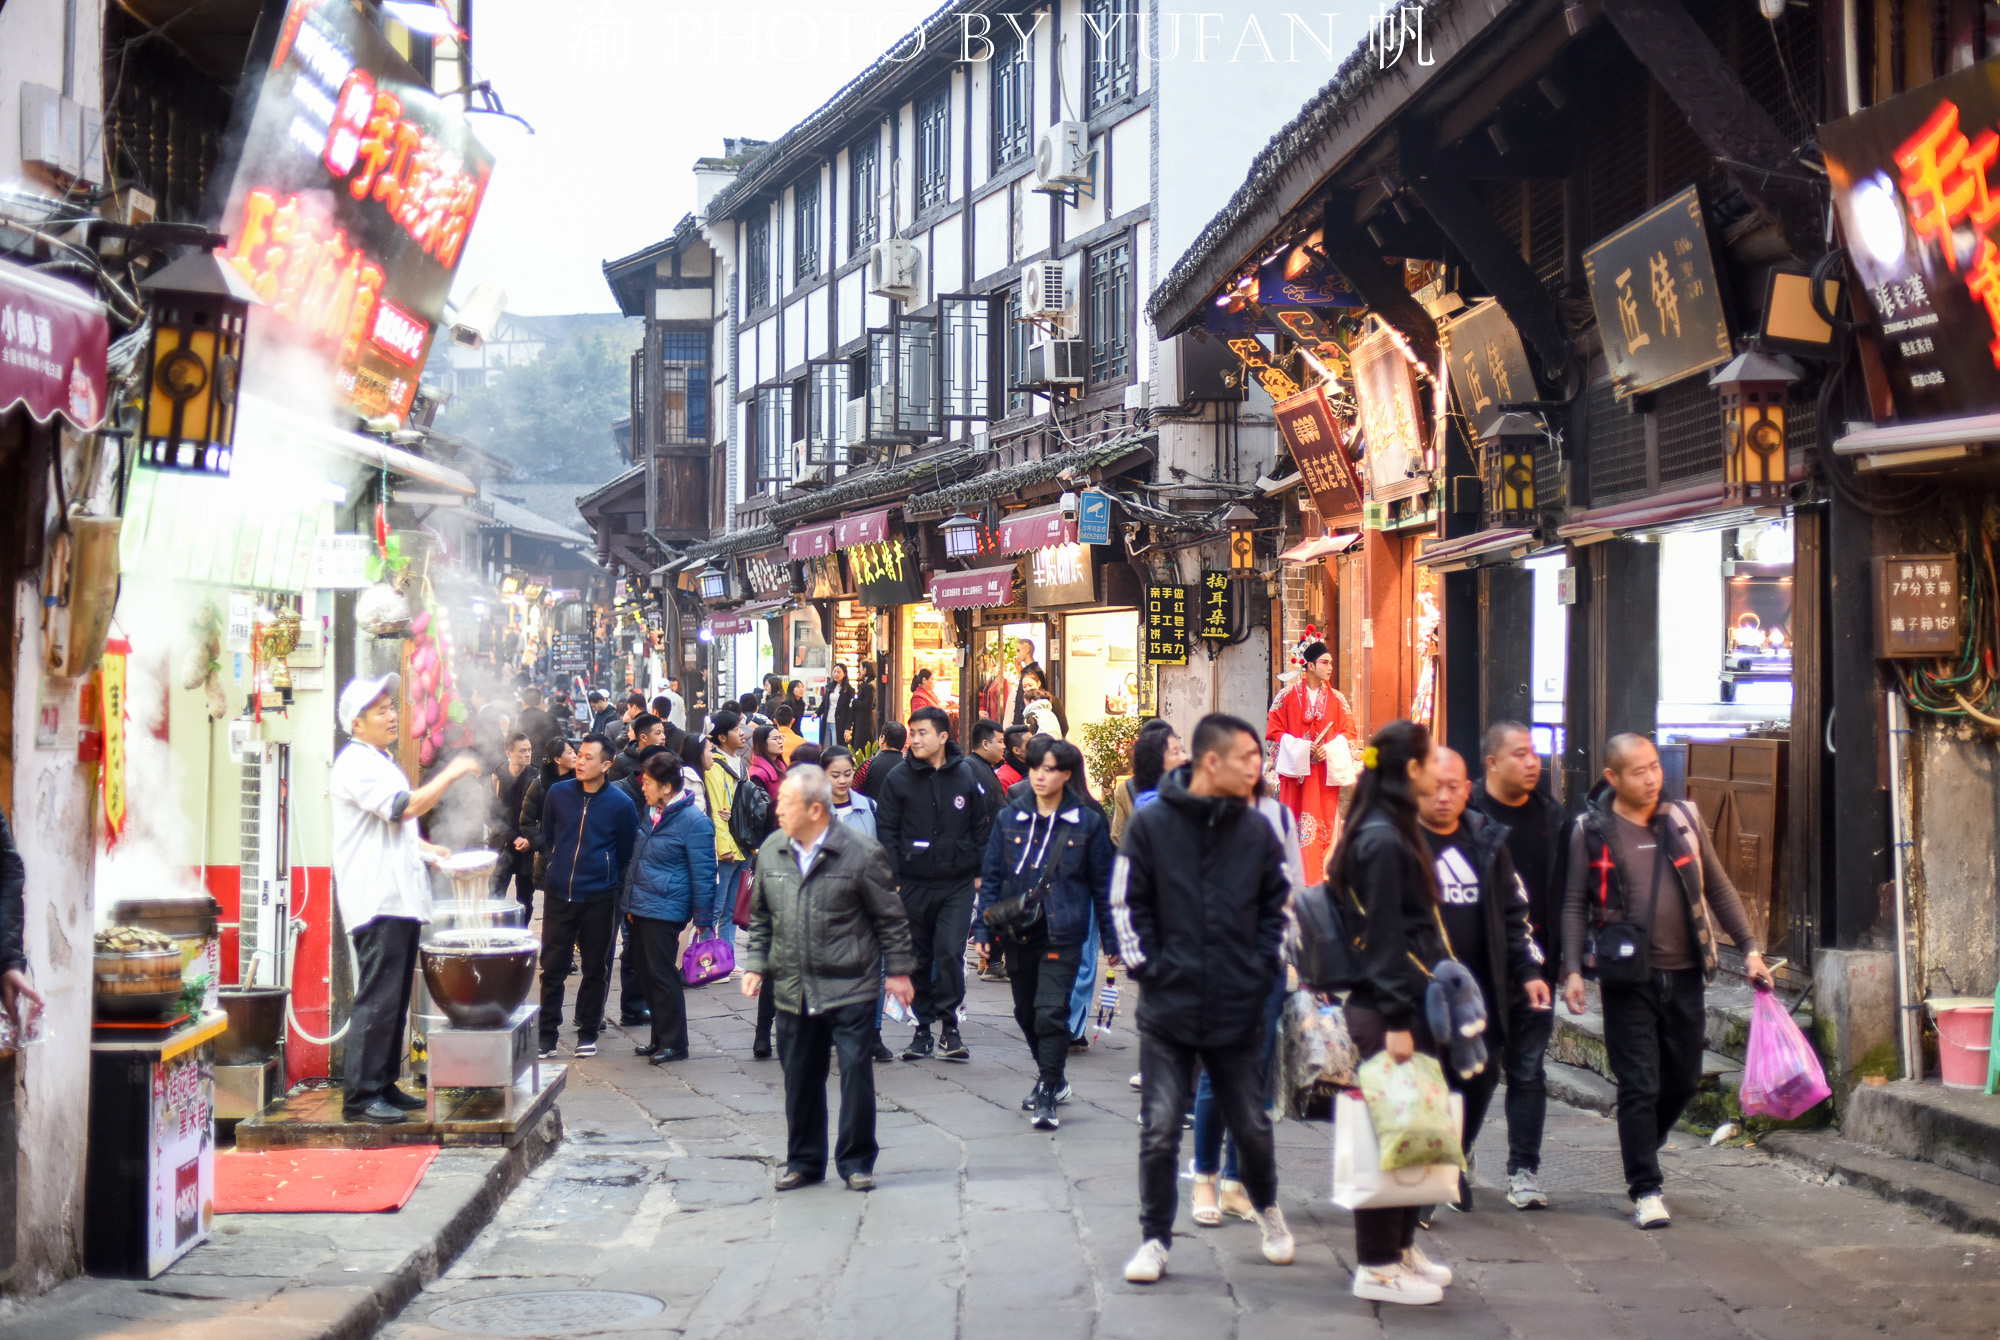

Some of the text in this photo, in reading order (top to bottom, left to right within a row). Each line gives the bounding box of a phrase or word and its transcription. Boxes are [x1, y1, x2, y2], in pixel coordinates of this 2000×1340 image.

[1150, 587, 1185, 599] 亲手做
[1206, 572, 1228, 626] 掏耳朵
[1150, 615, 1185, 627] 手工皂
[1150, 629, 1185, 641] 饼干
[1150, 642, 1185, 655] 巧克力
